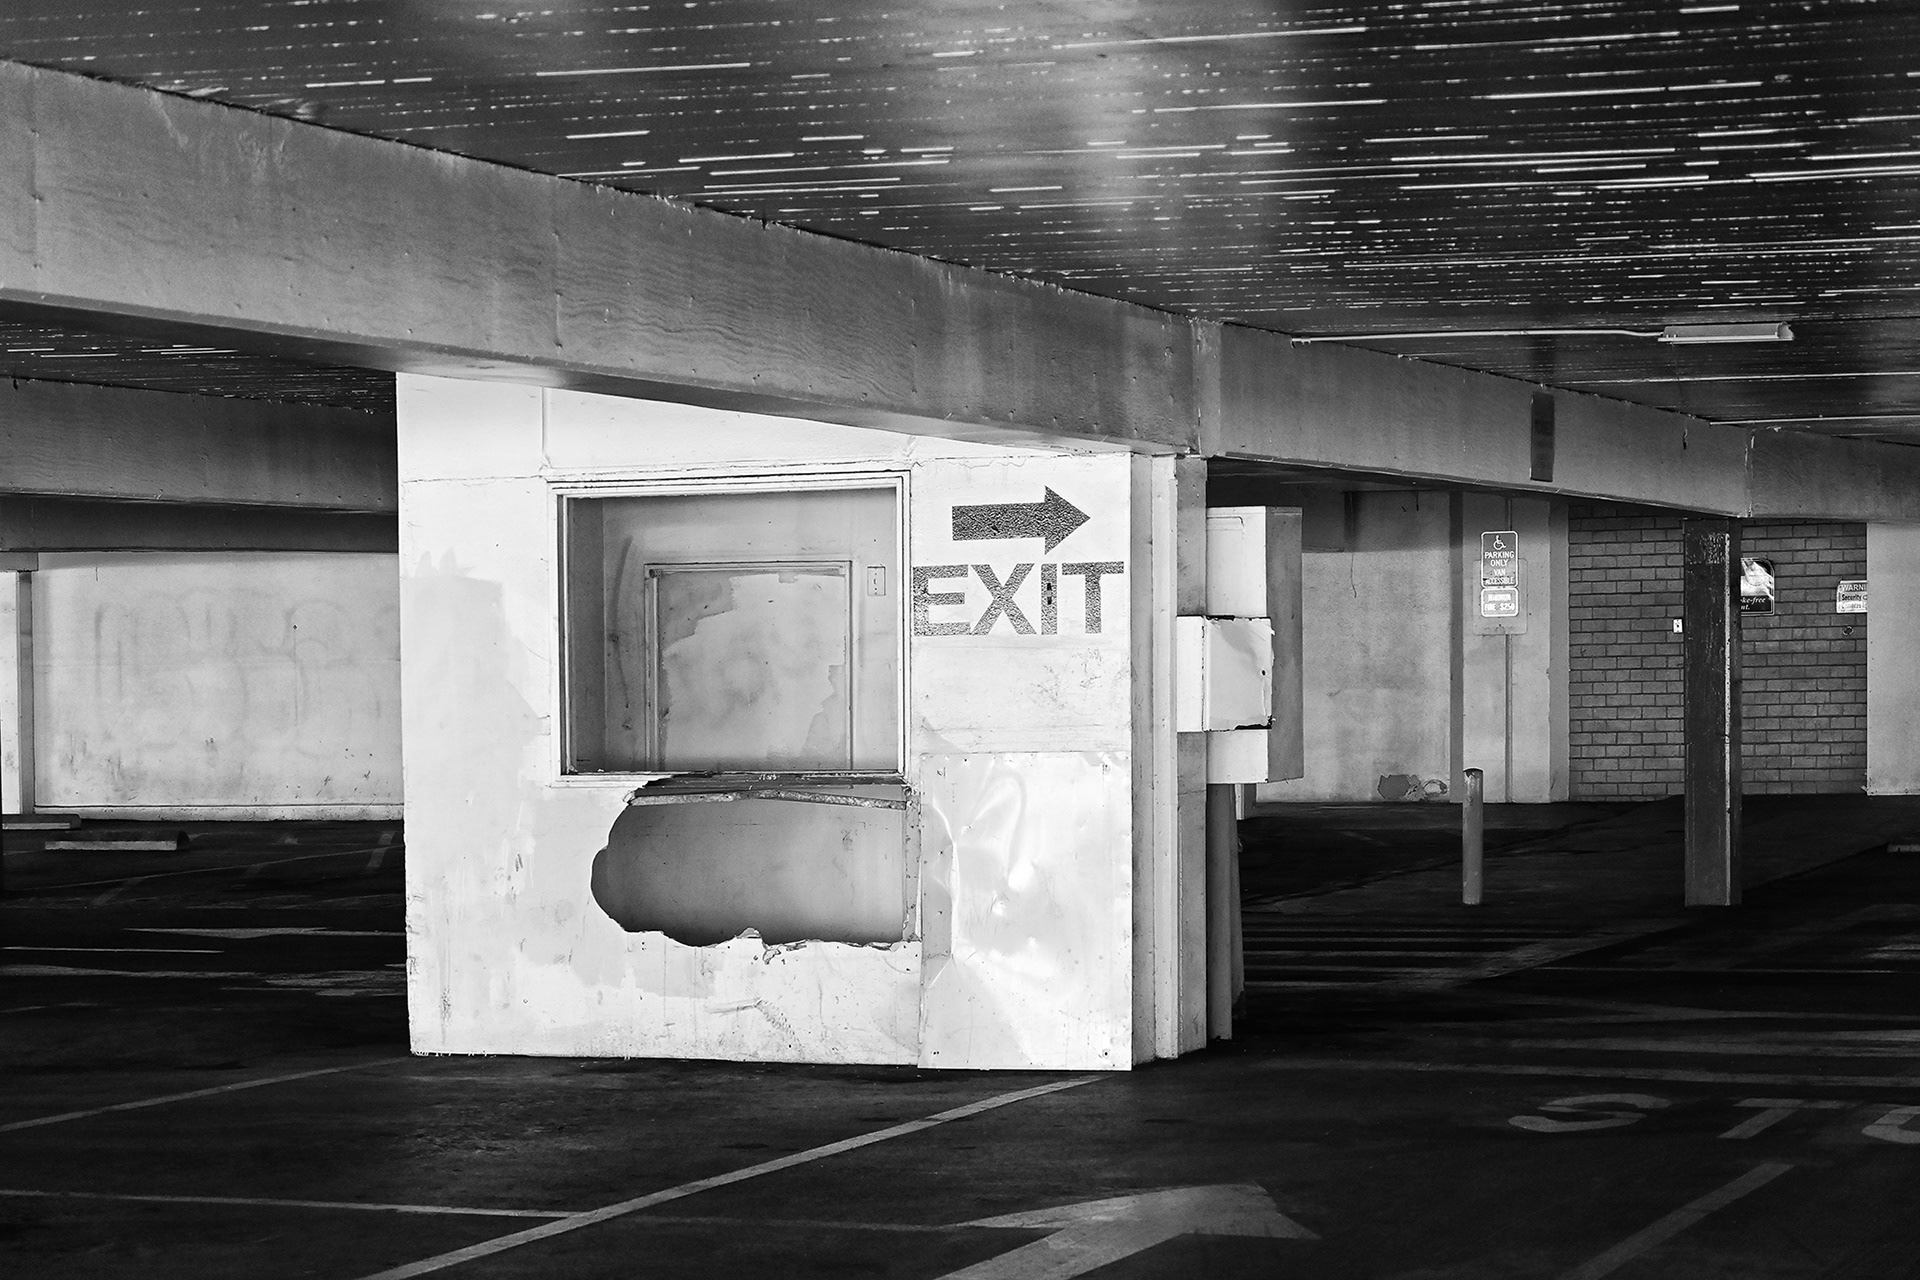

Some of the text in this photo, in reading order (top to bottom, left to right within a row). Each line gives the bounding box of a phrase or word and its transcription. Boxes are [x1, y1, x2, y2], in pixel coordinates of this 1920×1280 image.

[913, 561, 1124, 636] EXIT
[1740, 596, 1766, 605] ke-free
[1842, 594, 1862, 602] Security
